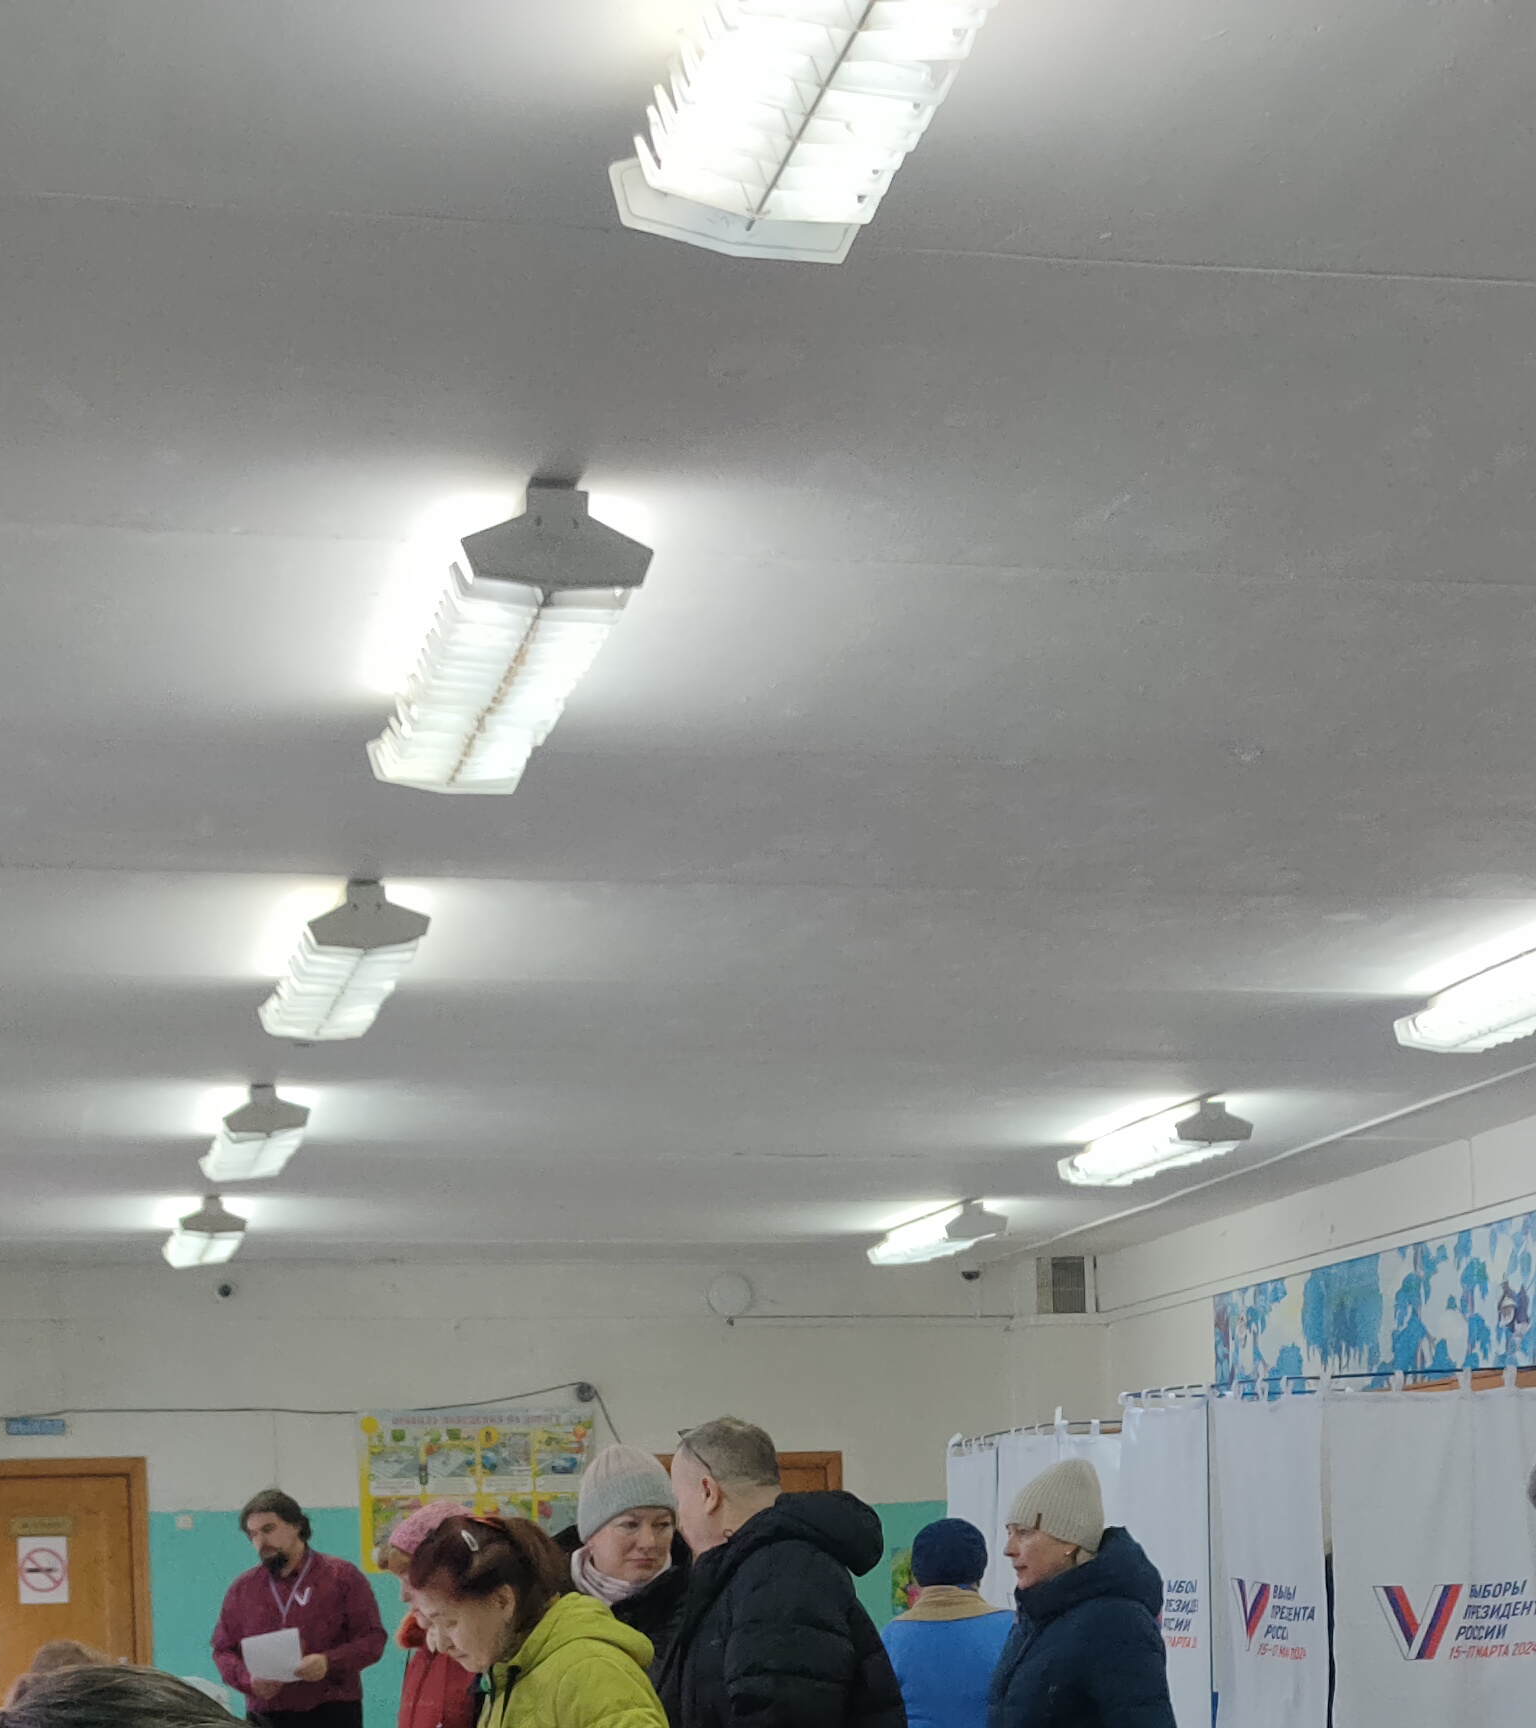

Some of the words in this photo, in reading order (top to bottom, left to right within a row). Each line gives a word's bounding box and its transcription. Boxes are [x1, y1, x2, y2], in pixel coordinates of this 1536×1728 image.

[1468, 1579, 1528, 1599] ВЫБОРЫ
[1454, 1623, 1509, 1642] РОССИИ
[1476, 1643, 1510, 1660] МАРТА
